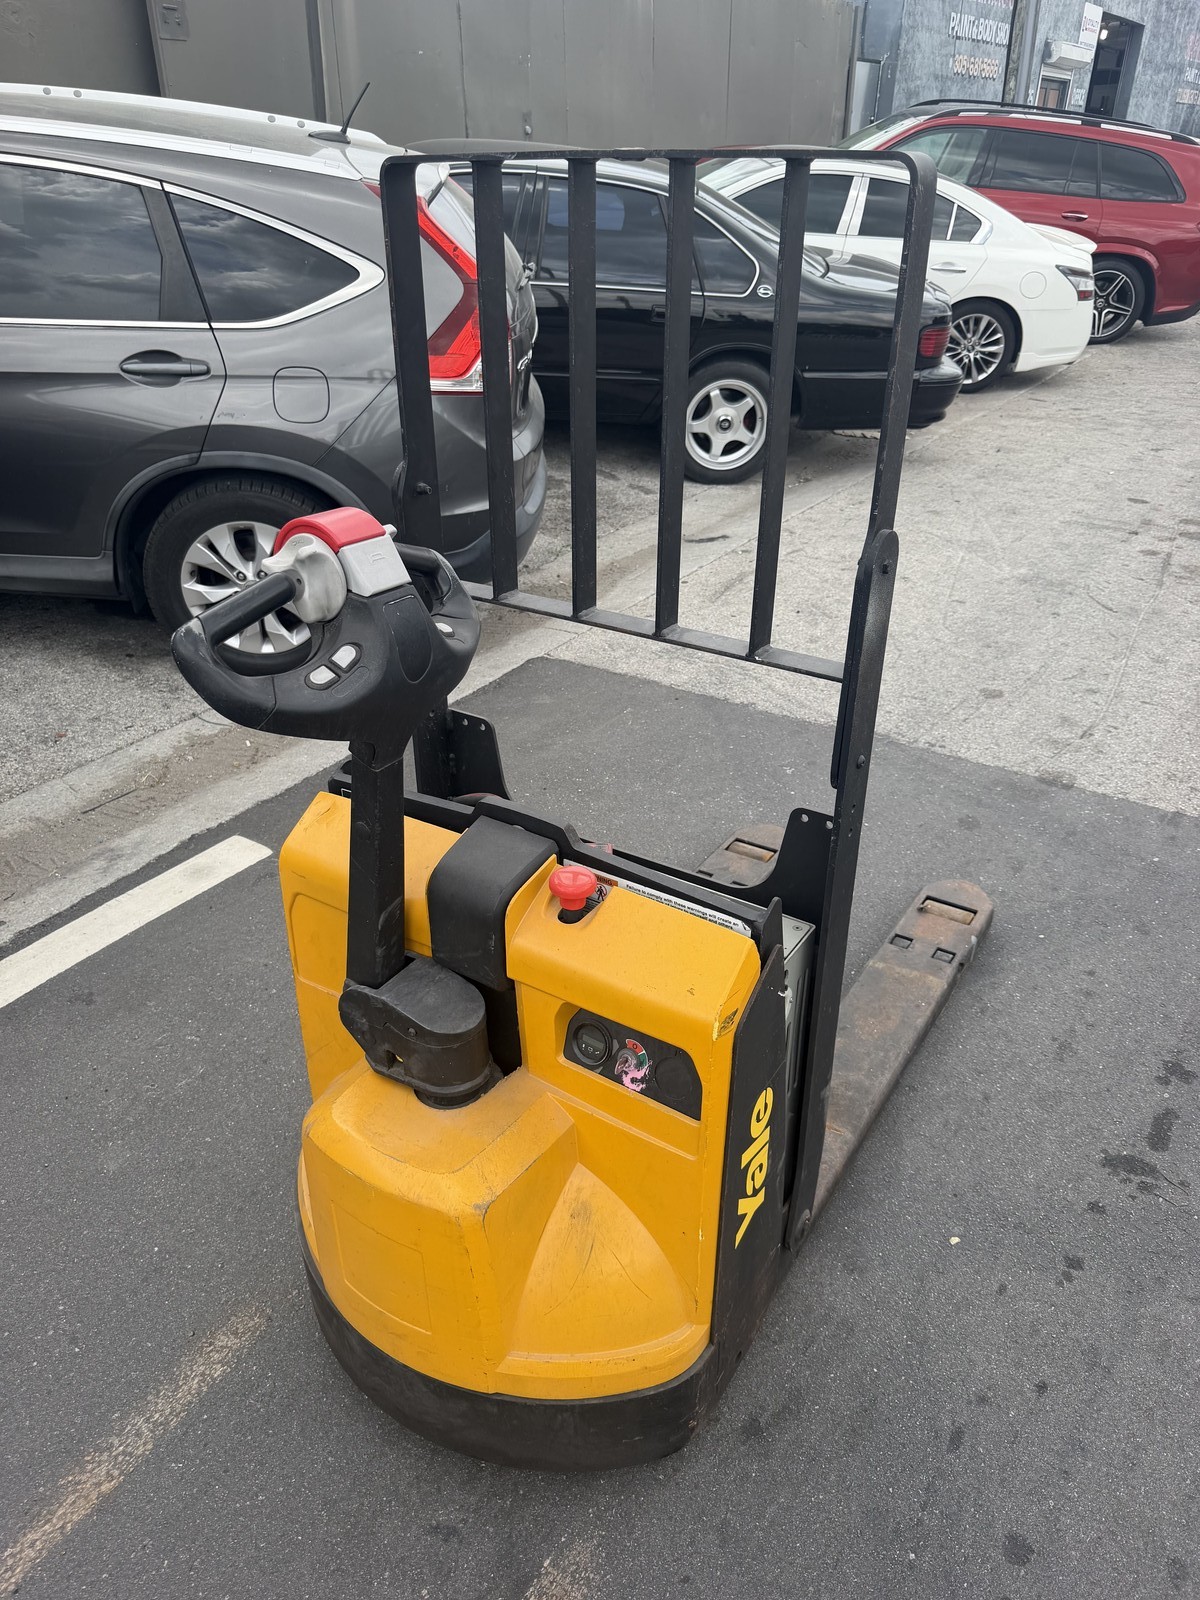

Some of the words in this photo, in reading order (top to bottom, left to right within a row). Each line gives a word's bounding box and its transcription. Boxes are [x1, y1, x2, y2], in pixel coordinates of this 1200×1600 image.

[626, 884, 641, 893] Failure
[647, 891, 663, 901] comply
[674, 900, 687, 909] these
[687, 905, 708, 917] warnings
[717, 915, 732, 925] create
[735, 1086, 774, 1250] Yale
